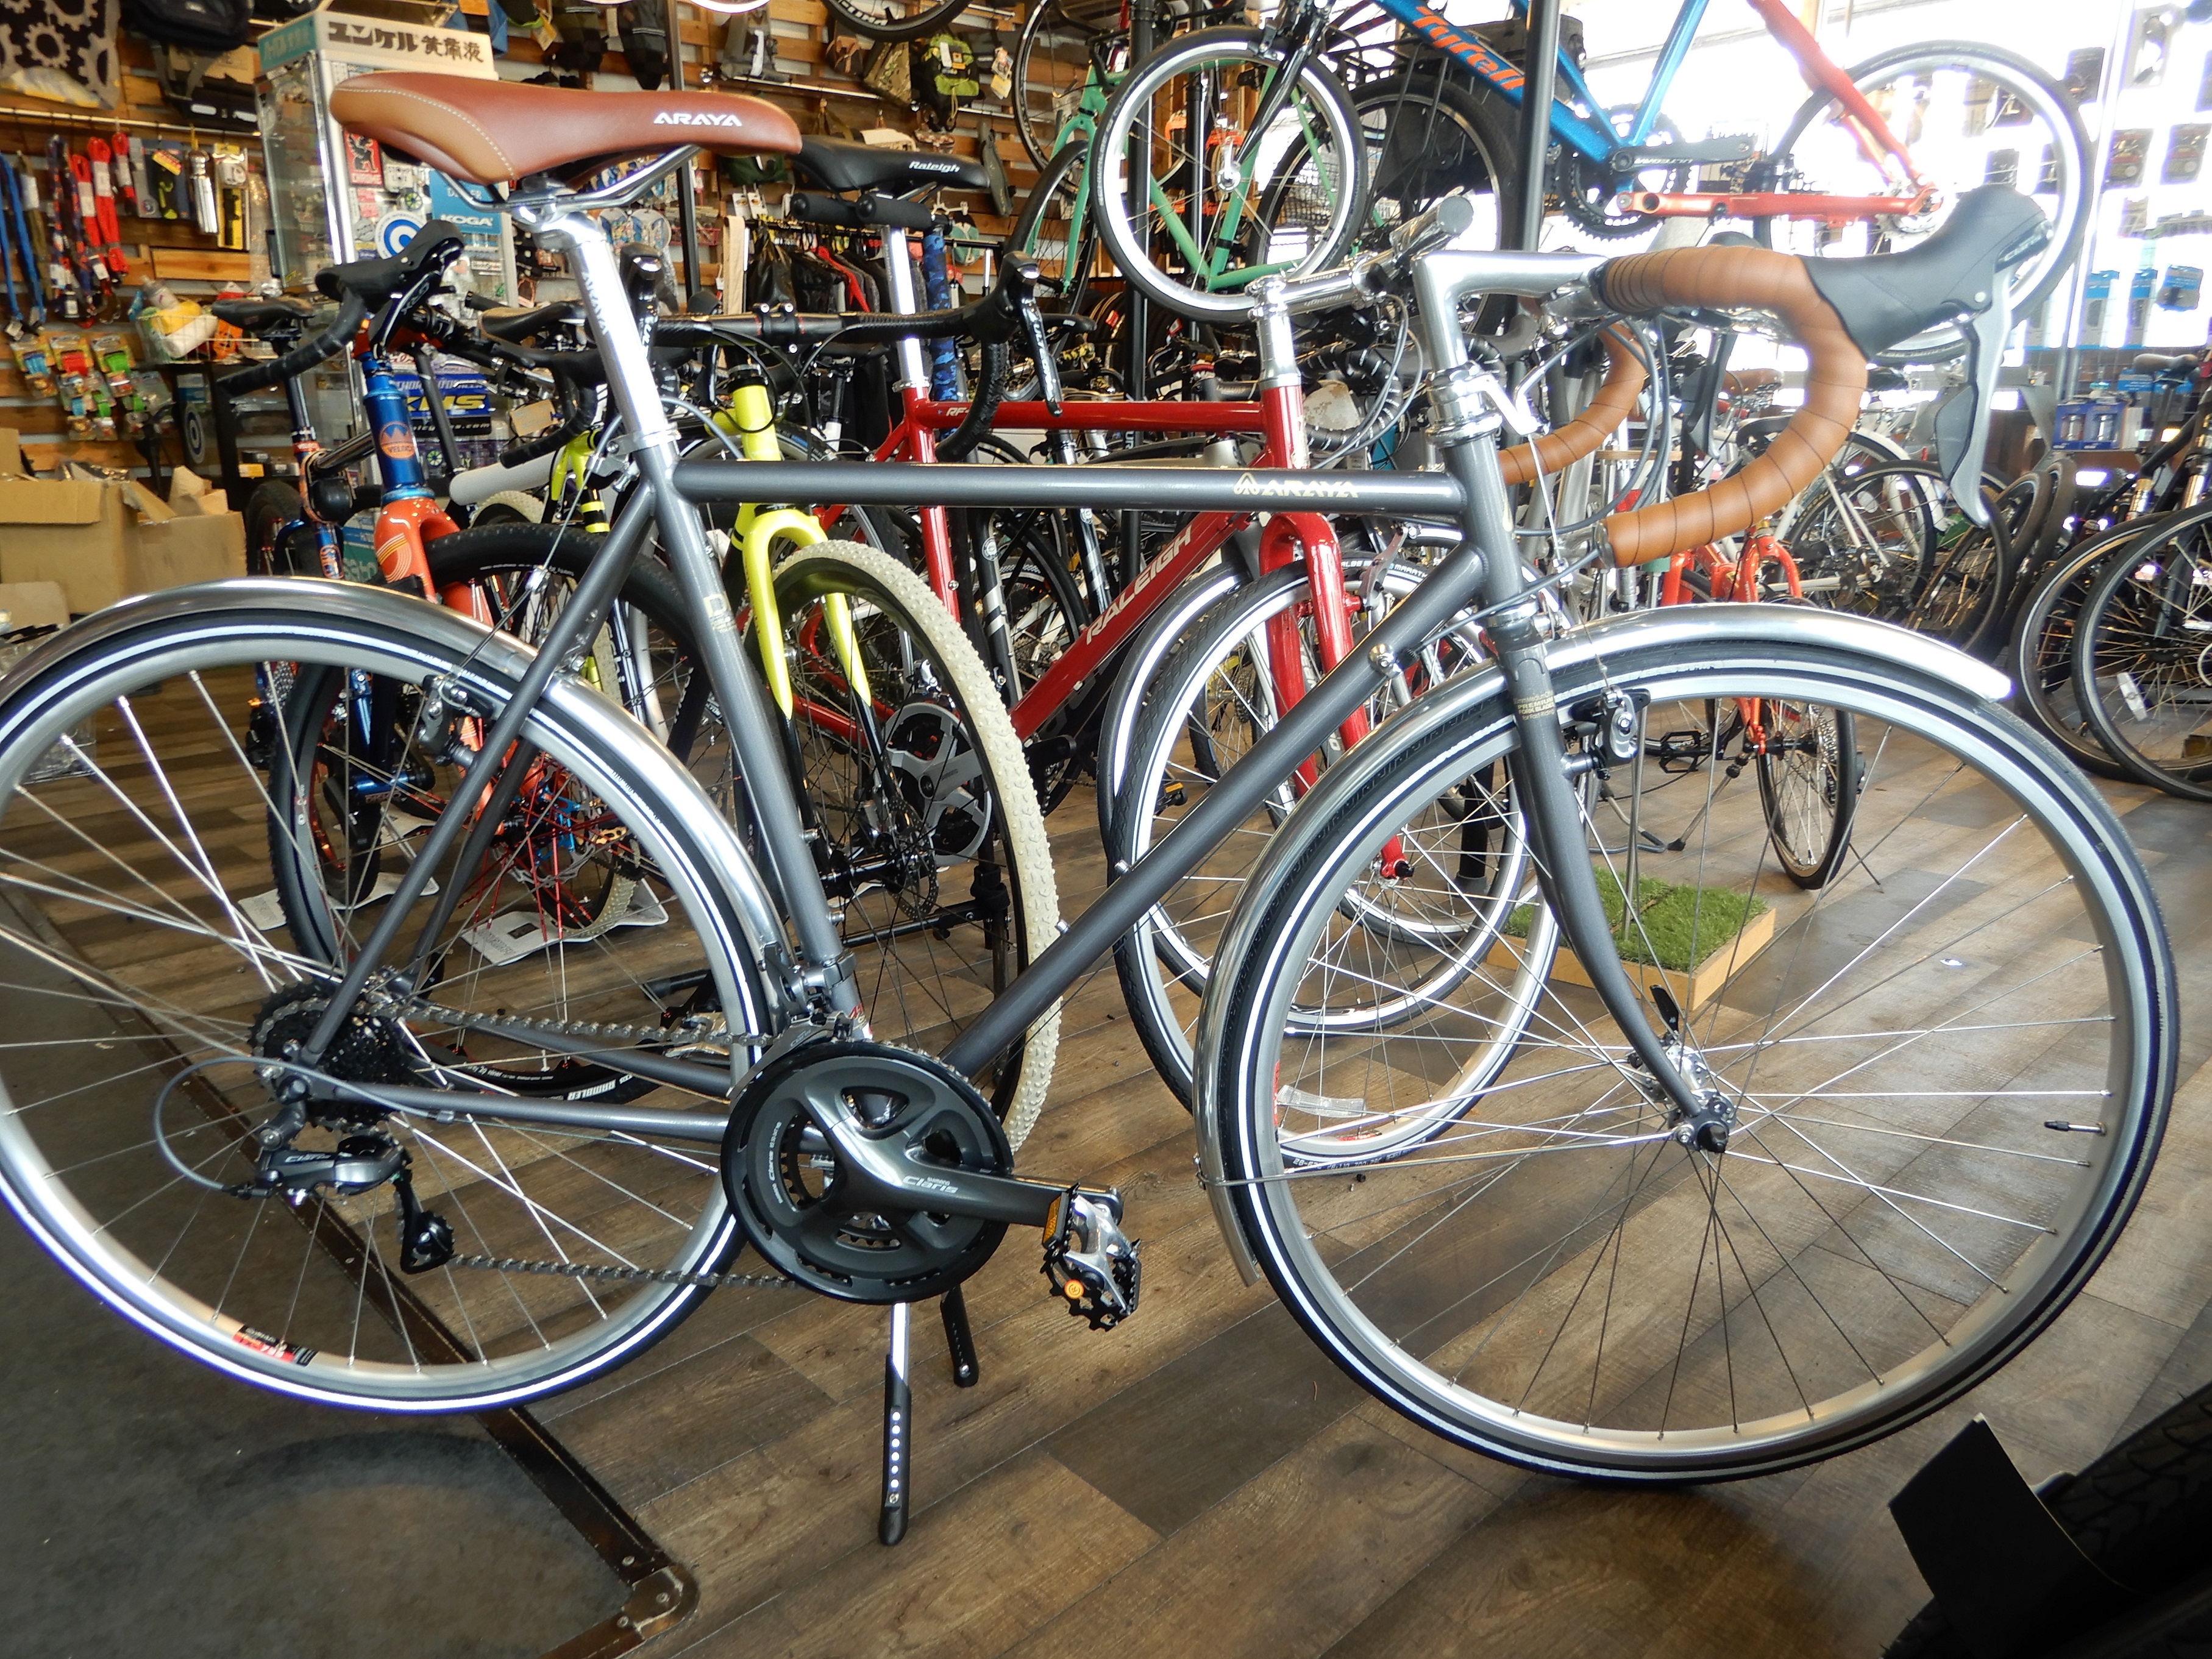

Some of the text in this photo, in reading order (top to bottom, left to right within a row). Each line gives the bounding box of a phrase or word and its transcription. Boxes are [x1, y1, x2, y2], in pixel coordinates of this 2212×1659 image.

[653, 112, 742, 127] ARAYA
[908, 160, 961, 173] Raleigh
[440, 215, 491, 226] KOGA
[1261, 480, 1359, 499] ARAYA
[1086, 525, 1192, 645] RALEIGH
[1518, 696, 1554, 709] PREMIUM
[567, 1079, 616, 1101] RAMBLER
[903, 1175, 959, 1194] Claris
[927, 1177, 950, 1185] SHIMANO
